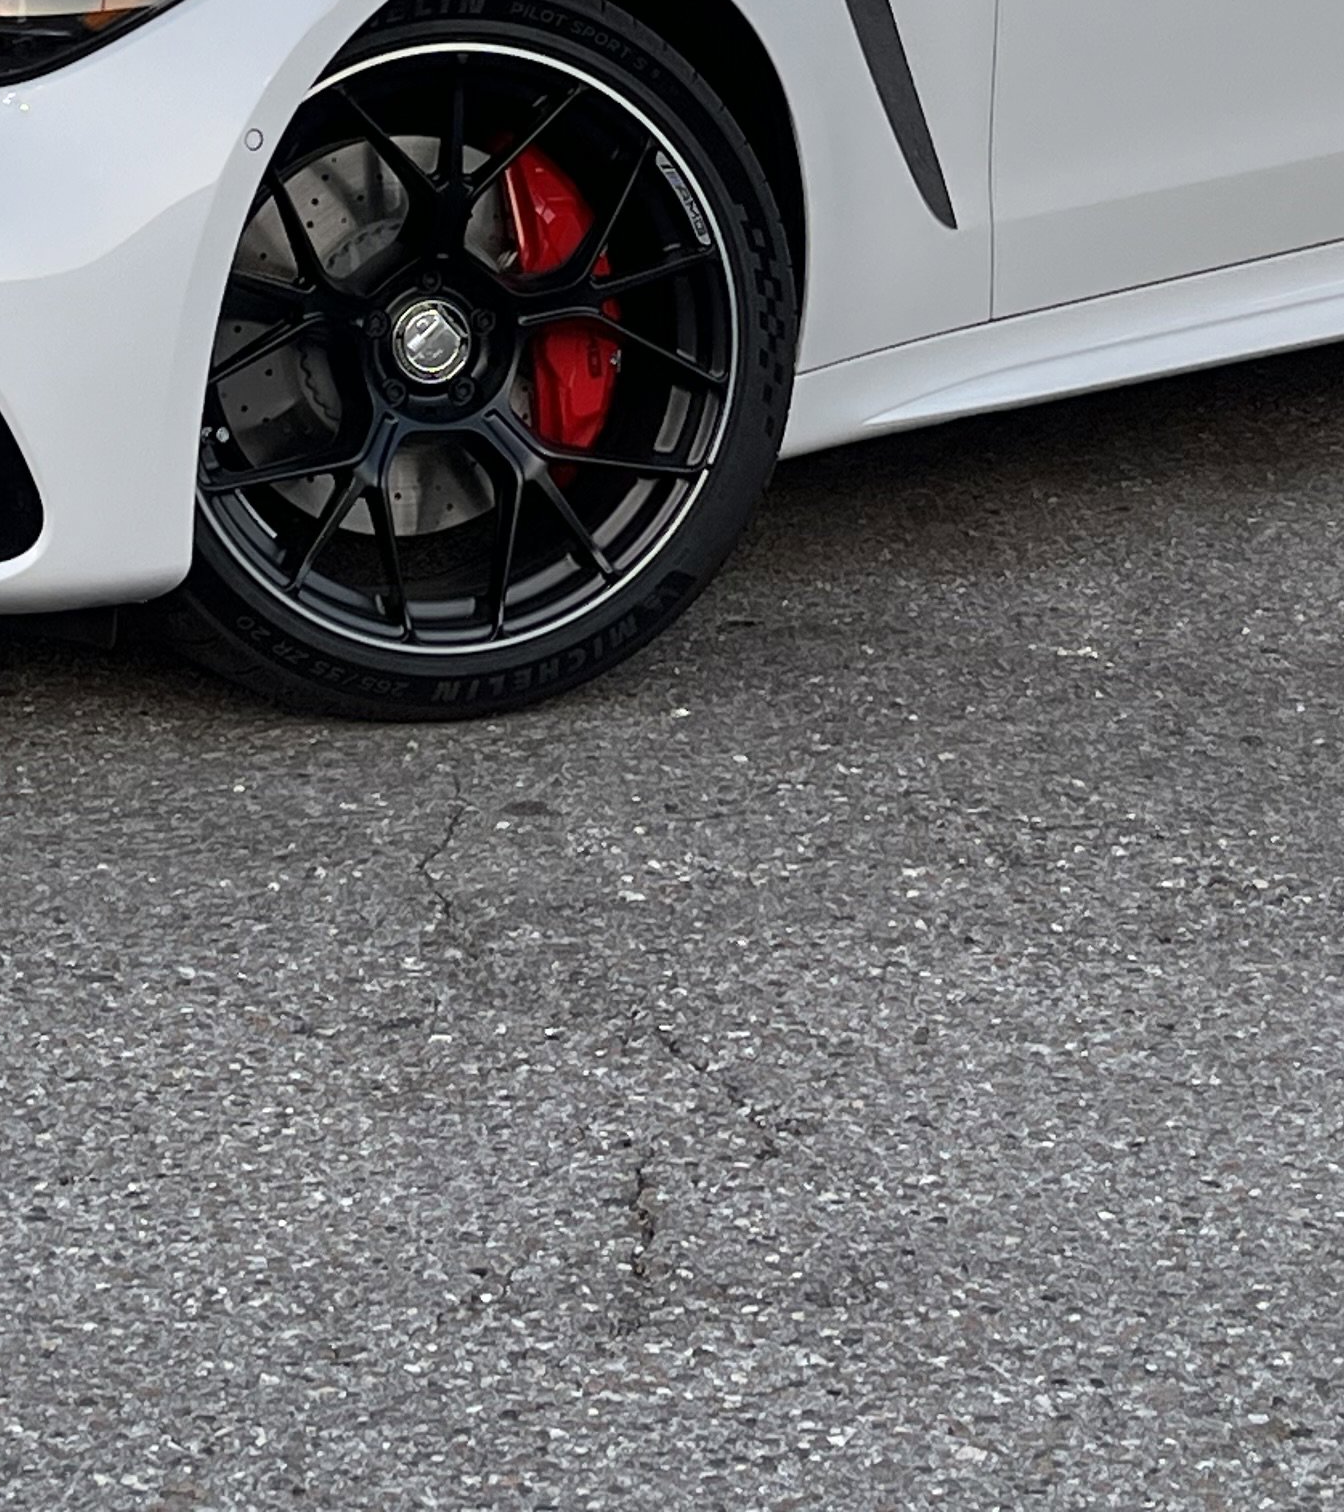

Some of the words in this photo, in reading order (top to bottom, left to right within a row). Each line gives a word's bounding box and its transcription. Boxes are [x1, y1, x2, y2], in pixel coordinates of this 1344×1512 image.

[508, 1, 567, 29] PILOT
[569, 19, 631, 62] SPORT
[233, 614, 273, 645] 20
[270, 633, 309, 666] ZR
[431, 616, 642, 705] MICHELIN
